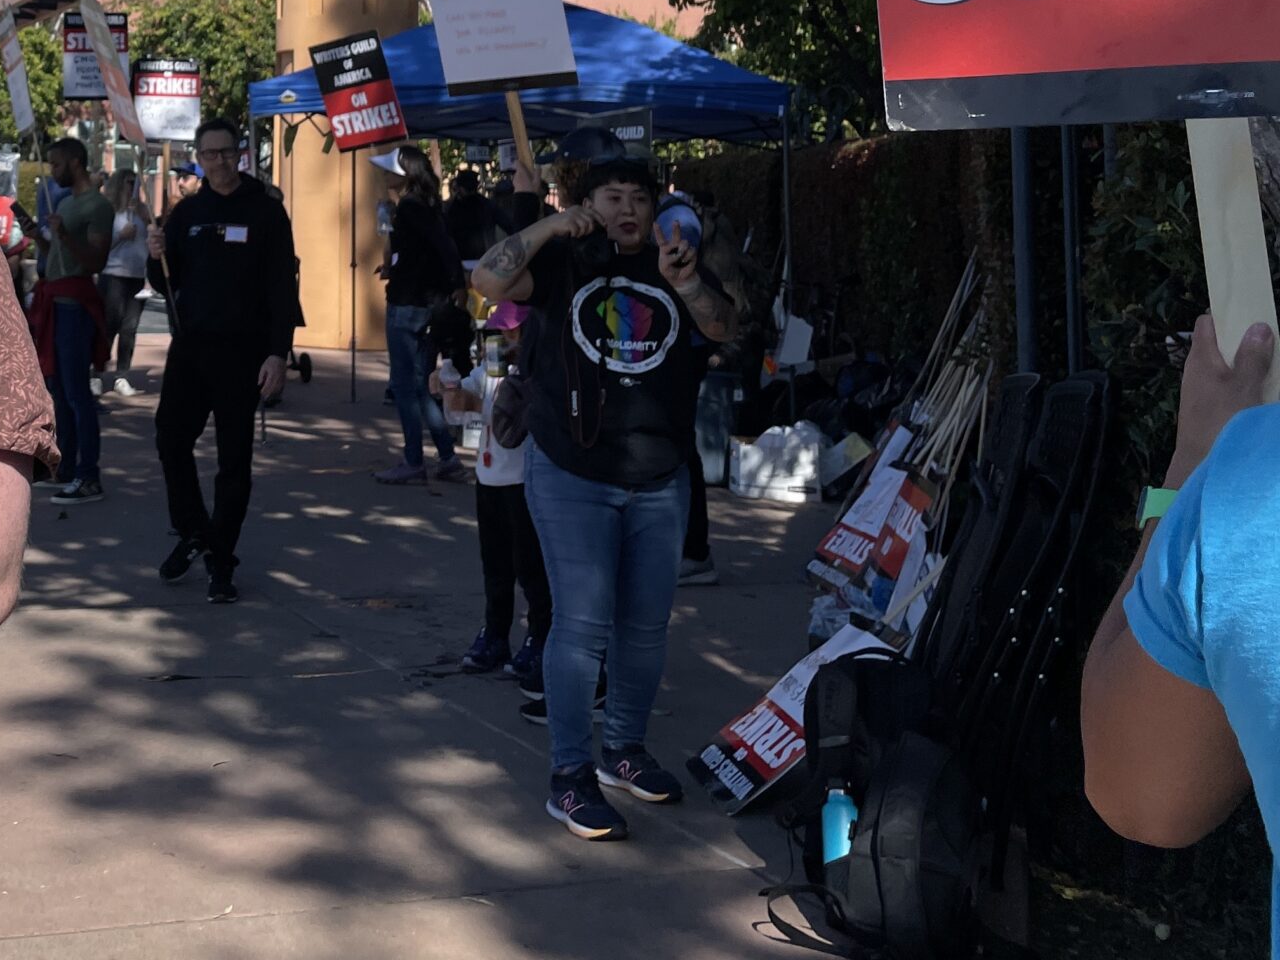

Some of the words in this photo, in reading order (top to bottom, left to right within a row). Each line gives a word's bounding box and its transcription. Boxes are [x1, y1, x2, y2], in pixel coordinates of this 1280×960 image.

[314, 45, 352, 64] WRITERS
[350, 38, 377, 55] GUILD
[139, 60, 174, 71] WRITERS
[174, 60, 198, 71] GUILD
[342, 58, 354, 70] OF
[334, 67, 373, 87] AMERICA
[138, 77, 197, 95] STRIKE!
[351, 91, 368, 108] ON
[331, 101, 400, 138] STRIKE!
[615, 125, 644, 140] GUILD
